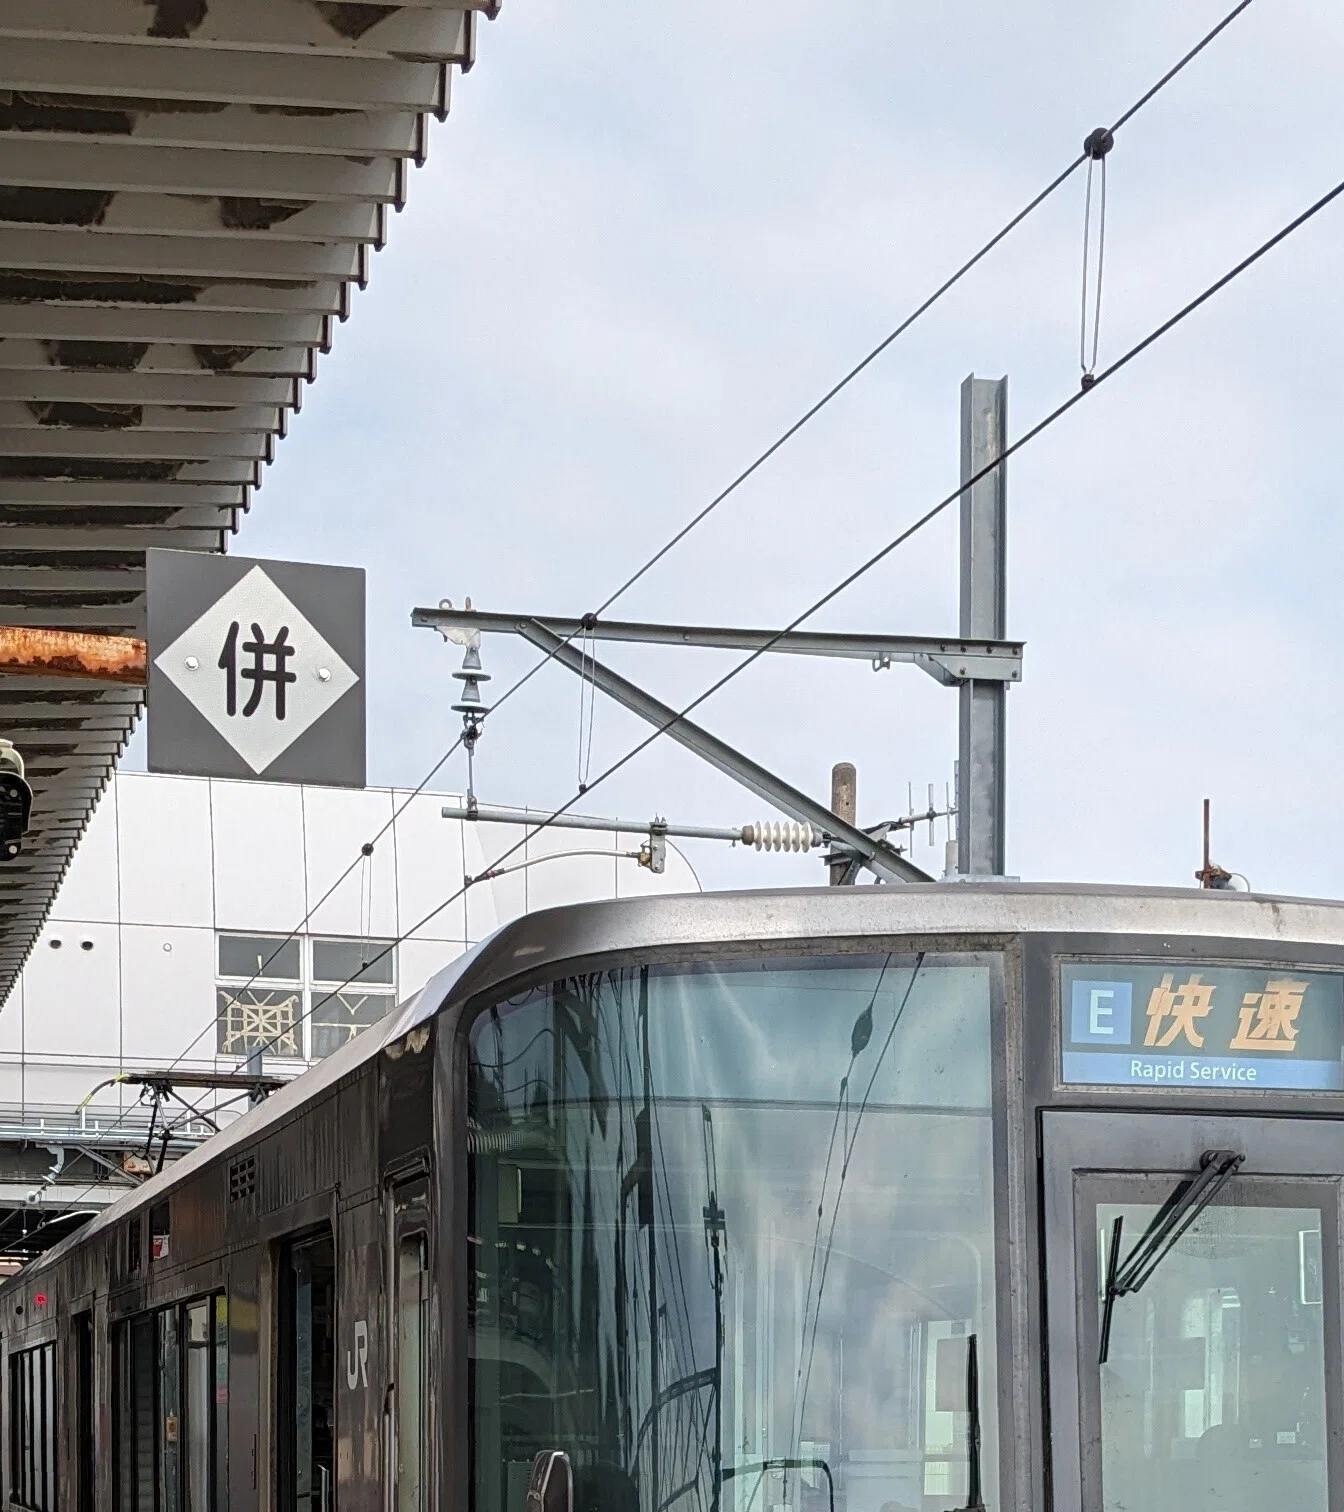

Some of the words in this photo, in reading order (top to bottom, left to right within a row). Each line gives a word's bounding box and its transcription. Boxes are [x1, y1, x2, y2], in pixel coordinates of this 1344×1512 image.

[218, 620, 297, 721] 併
[1089, 989, 1115, 1035] E
[1143, 971, 1311, 1051] 快速
[1130, 1059, 1184, 1083] Rapid
[1190, 1061, 1257, 1082] Service
[346, 1320, 369, 1390] JR
